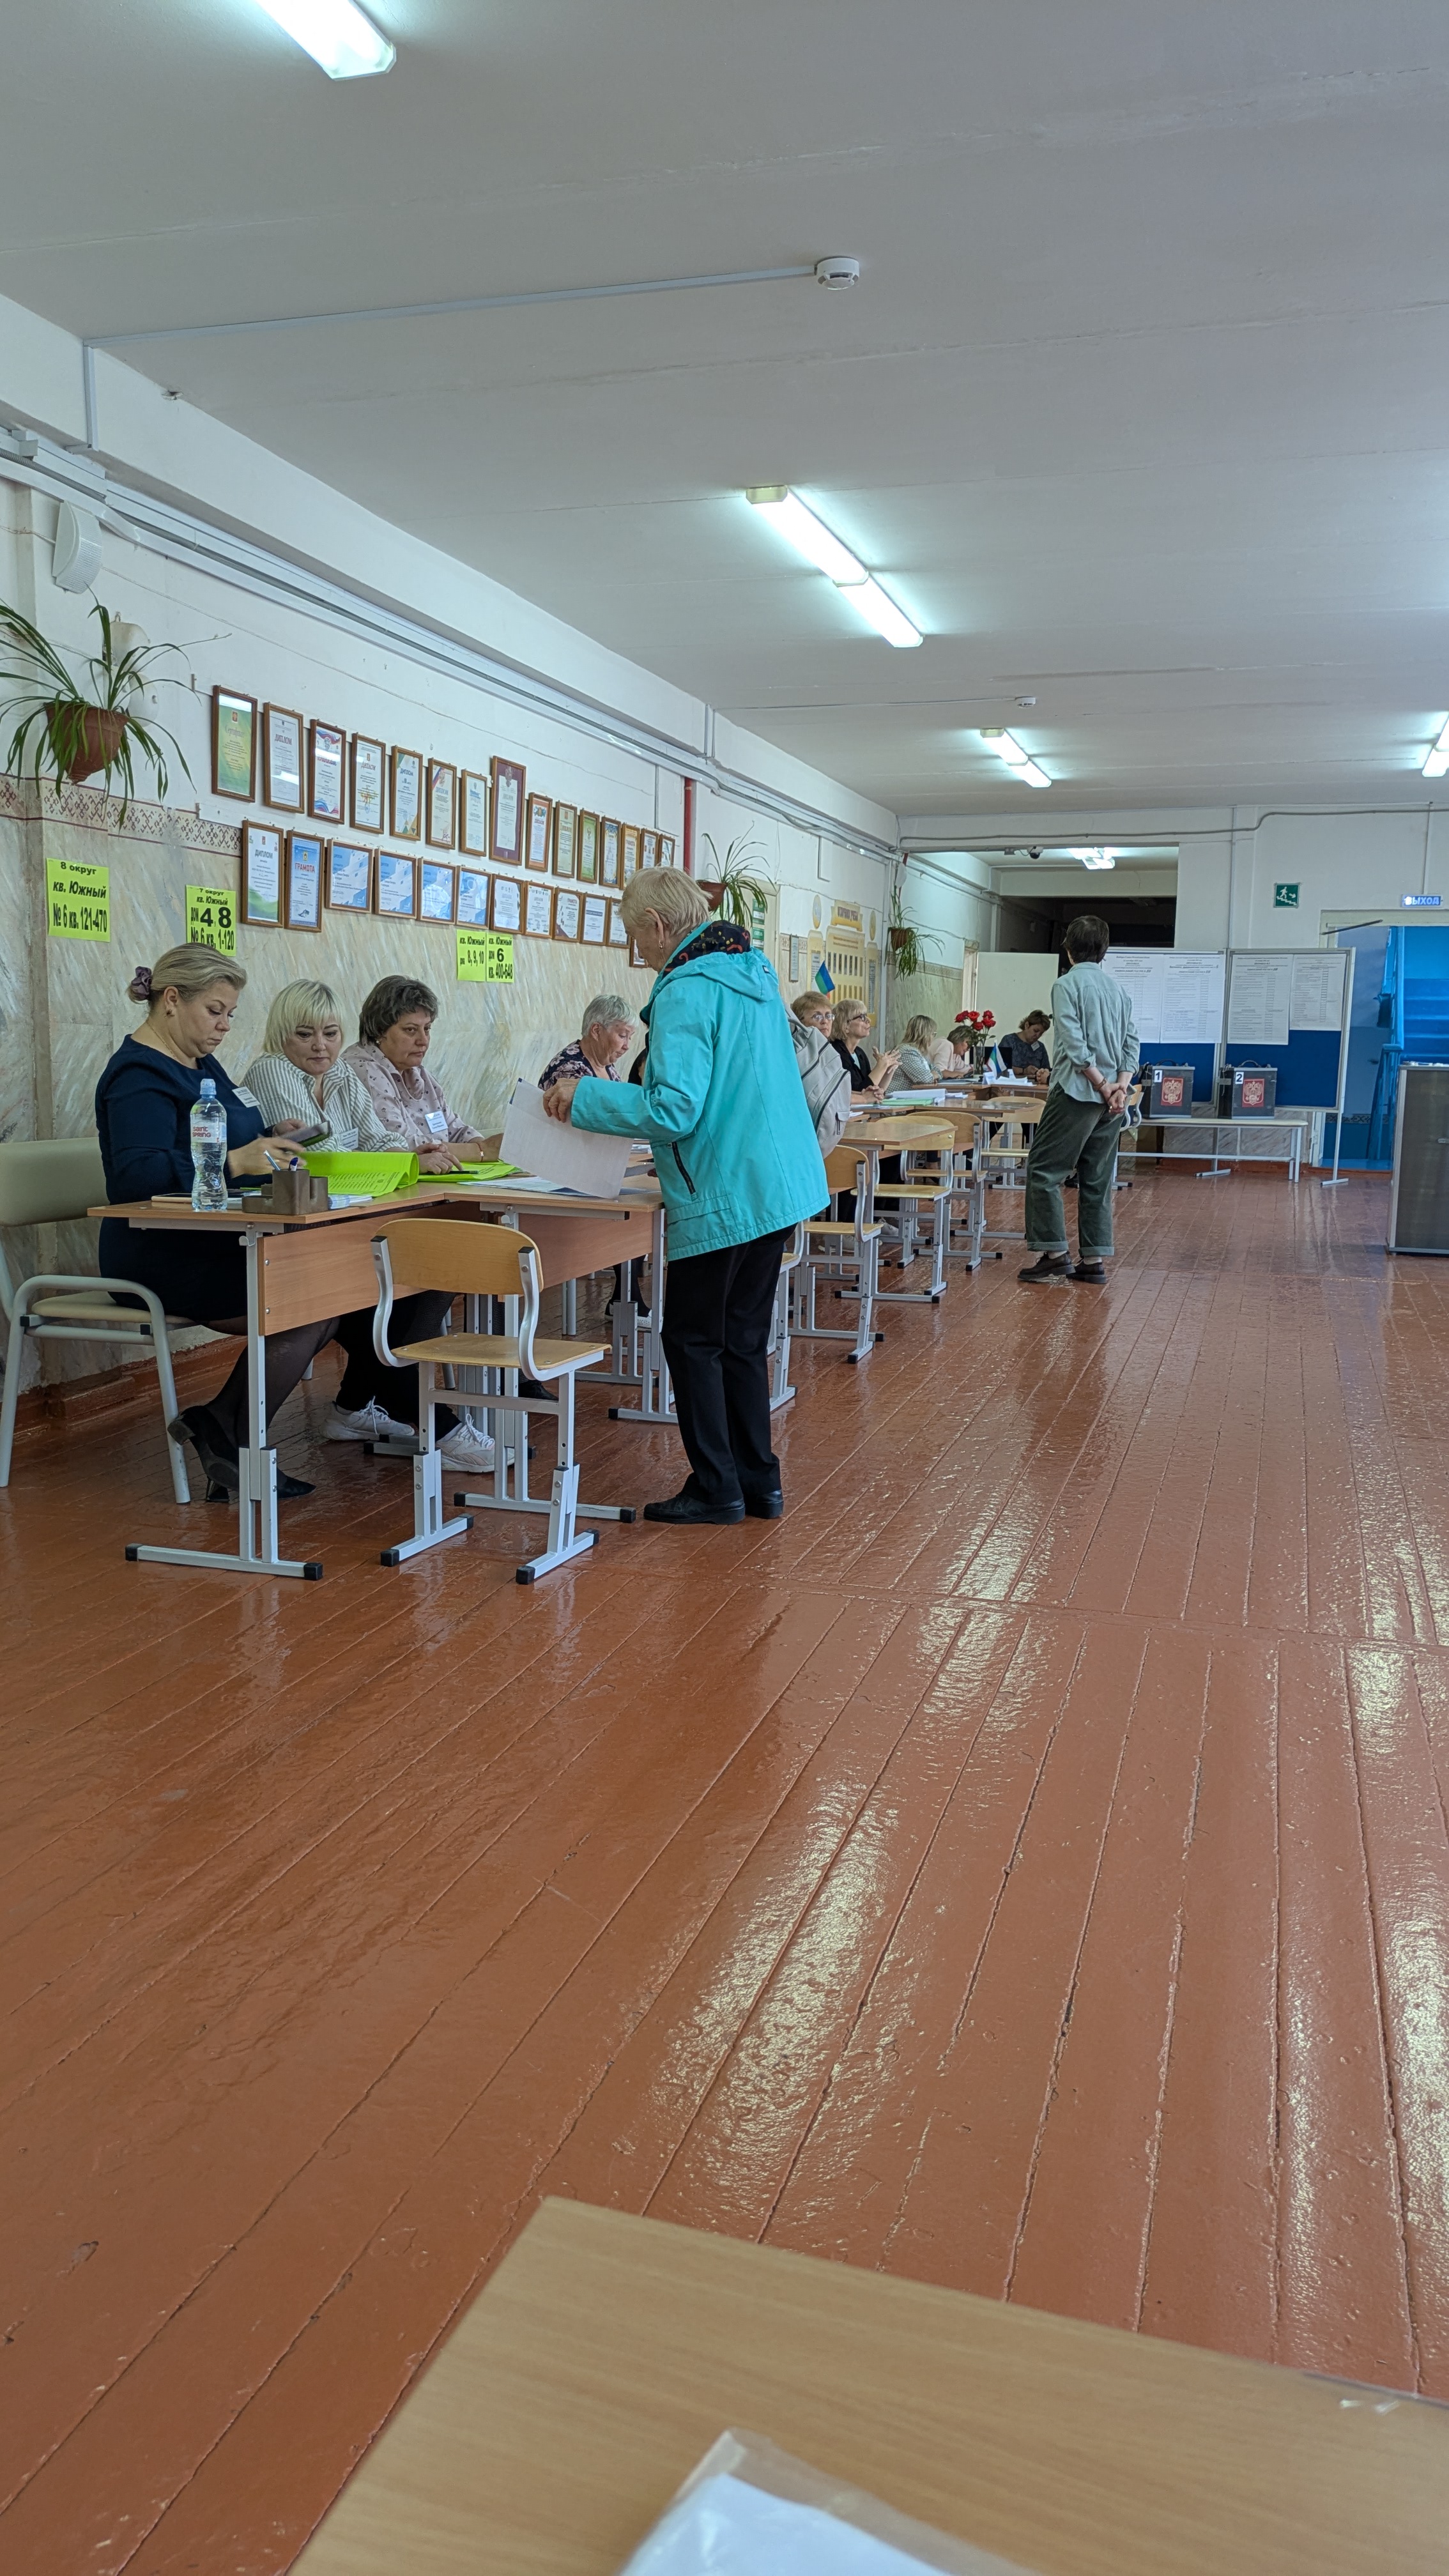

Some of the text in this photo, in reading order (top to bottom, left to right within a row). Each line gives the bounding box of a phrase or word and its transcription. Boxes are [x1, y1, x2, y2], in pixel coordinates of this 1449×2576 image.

[255, 849, 273, 859] ДИПЛОМ
[61, 861, 96, 875] 8 округ
[295, 862, 315, 873] ГРАМОТА
[53, 880, 107, 899] кв. Южный
[206, 896, 228, 906] Южный
[1405, 896, 1439, 905] ВЫХОД
[53, 903, 107, 933] № 6 кв. 121-470
[218, 907, 232, 928] 8
[218, 929, 234, 951] 1-120
[467, 936, 485, 945] Южный
[496, 936, 512, 946] Южный
[479, 950, 484, 964] 10
[497, 948, 504, 962] 6
[496, 963, 513, 979] 400-648
[1155, 1071, 1161, 1081] 1
[1236, 1073, 1243, 1082] 2
